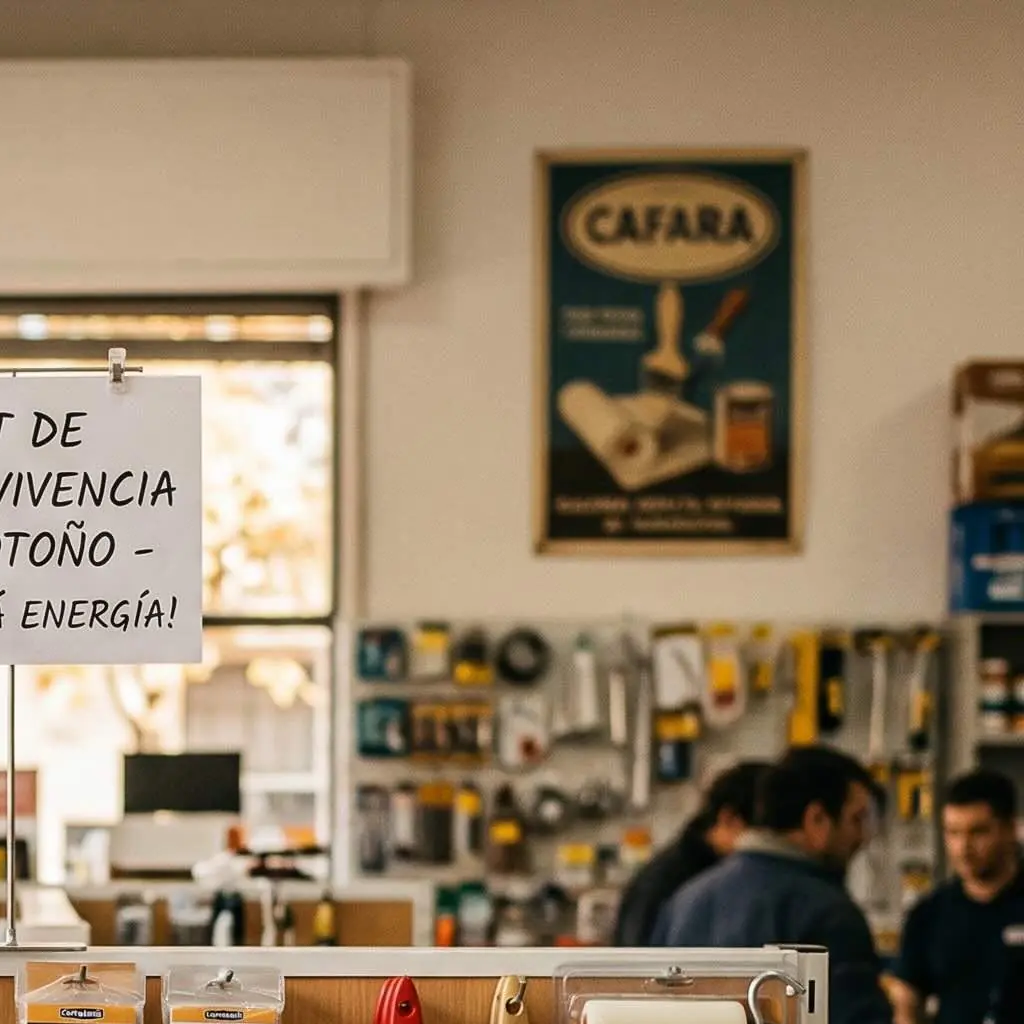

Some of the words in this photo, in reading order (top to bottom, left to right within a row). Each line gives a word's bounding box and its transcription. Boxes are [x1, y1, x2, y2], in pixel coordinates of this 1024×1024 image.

[586, 204, 755, 243] CAFARA
[31, 411, 87, 448] DE
[21, 590, 178, 632] ENERGÍA!
